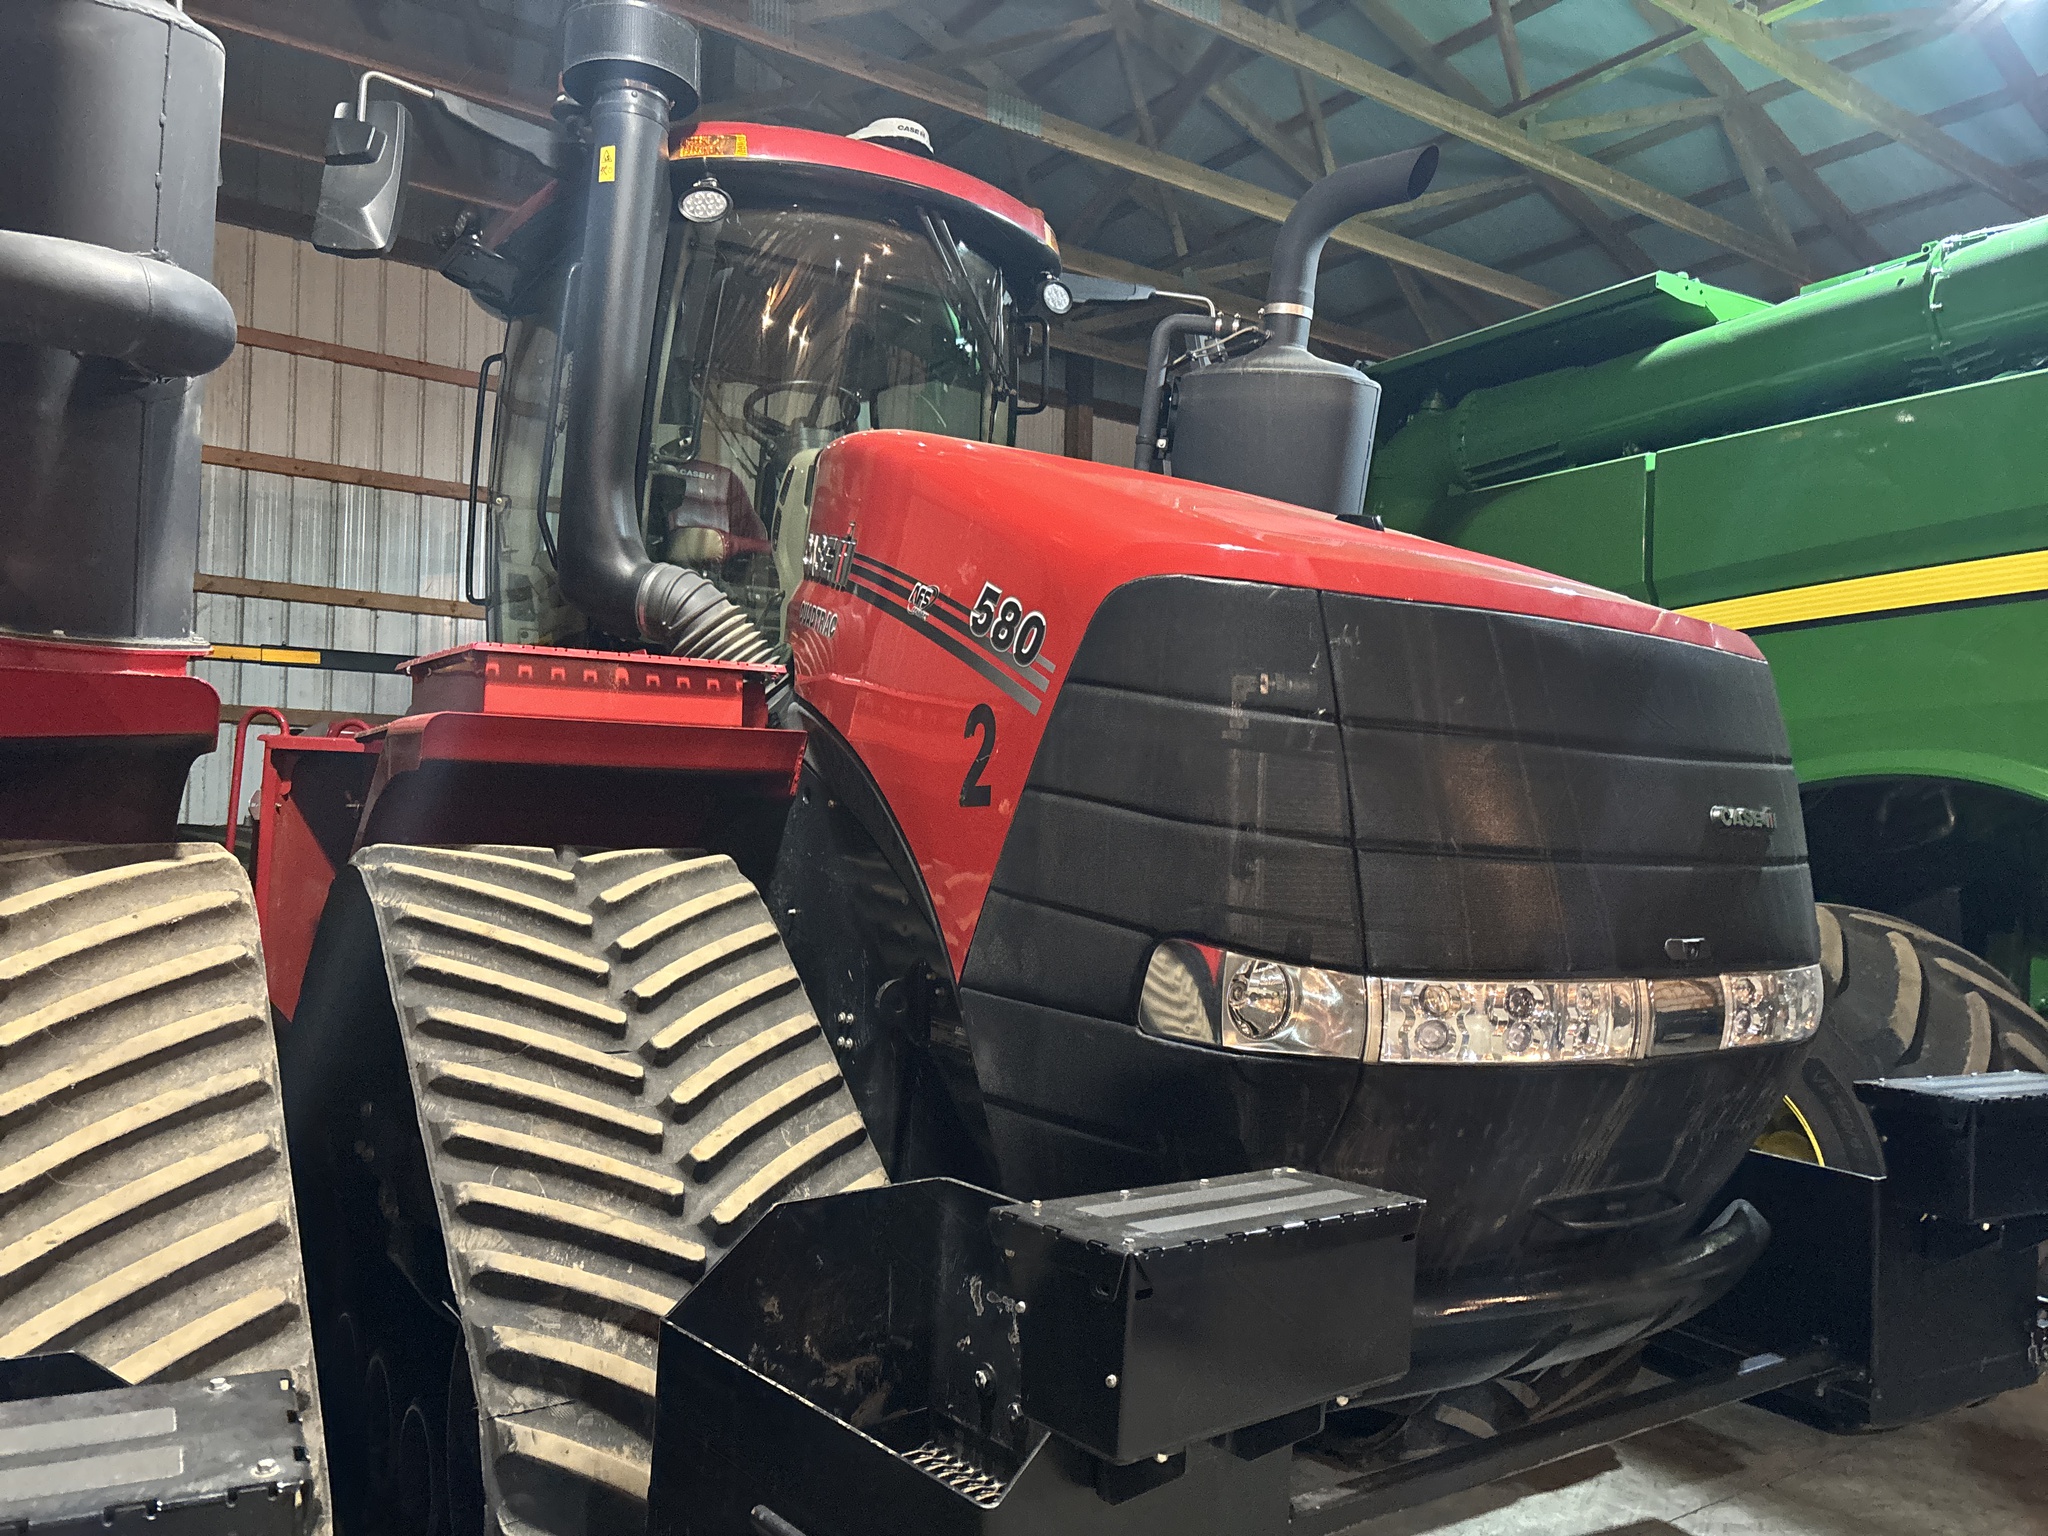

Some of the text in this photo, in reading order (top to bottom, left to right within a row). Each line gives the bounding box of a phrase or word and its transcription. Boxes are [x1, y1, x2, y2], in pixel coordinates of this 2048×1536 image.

[897, 124, 920, 135] CASE
[680, 469, 705, 479] CASE
[908, 582, 934, 610] AFS
[799, 600, 839, 639] QUADTRAC
[970, 580, 1046, 667] 580
[959, 703, 997, 808] 2
[1720, 805, 1763, 828] CASE
